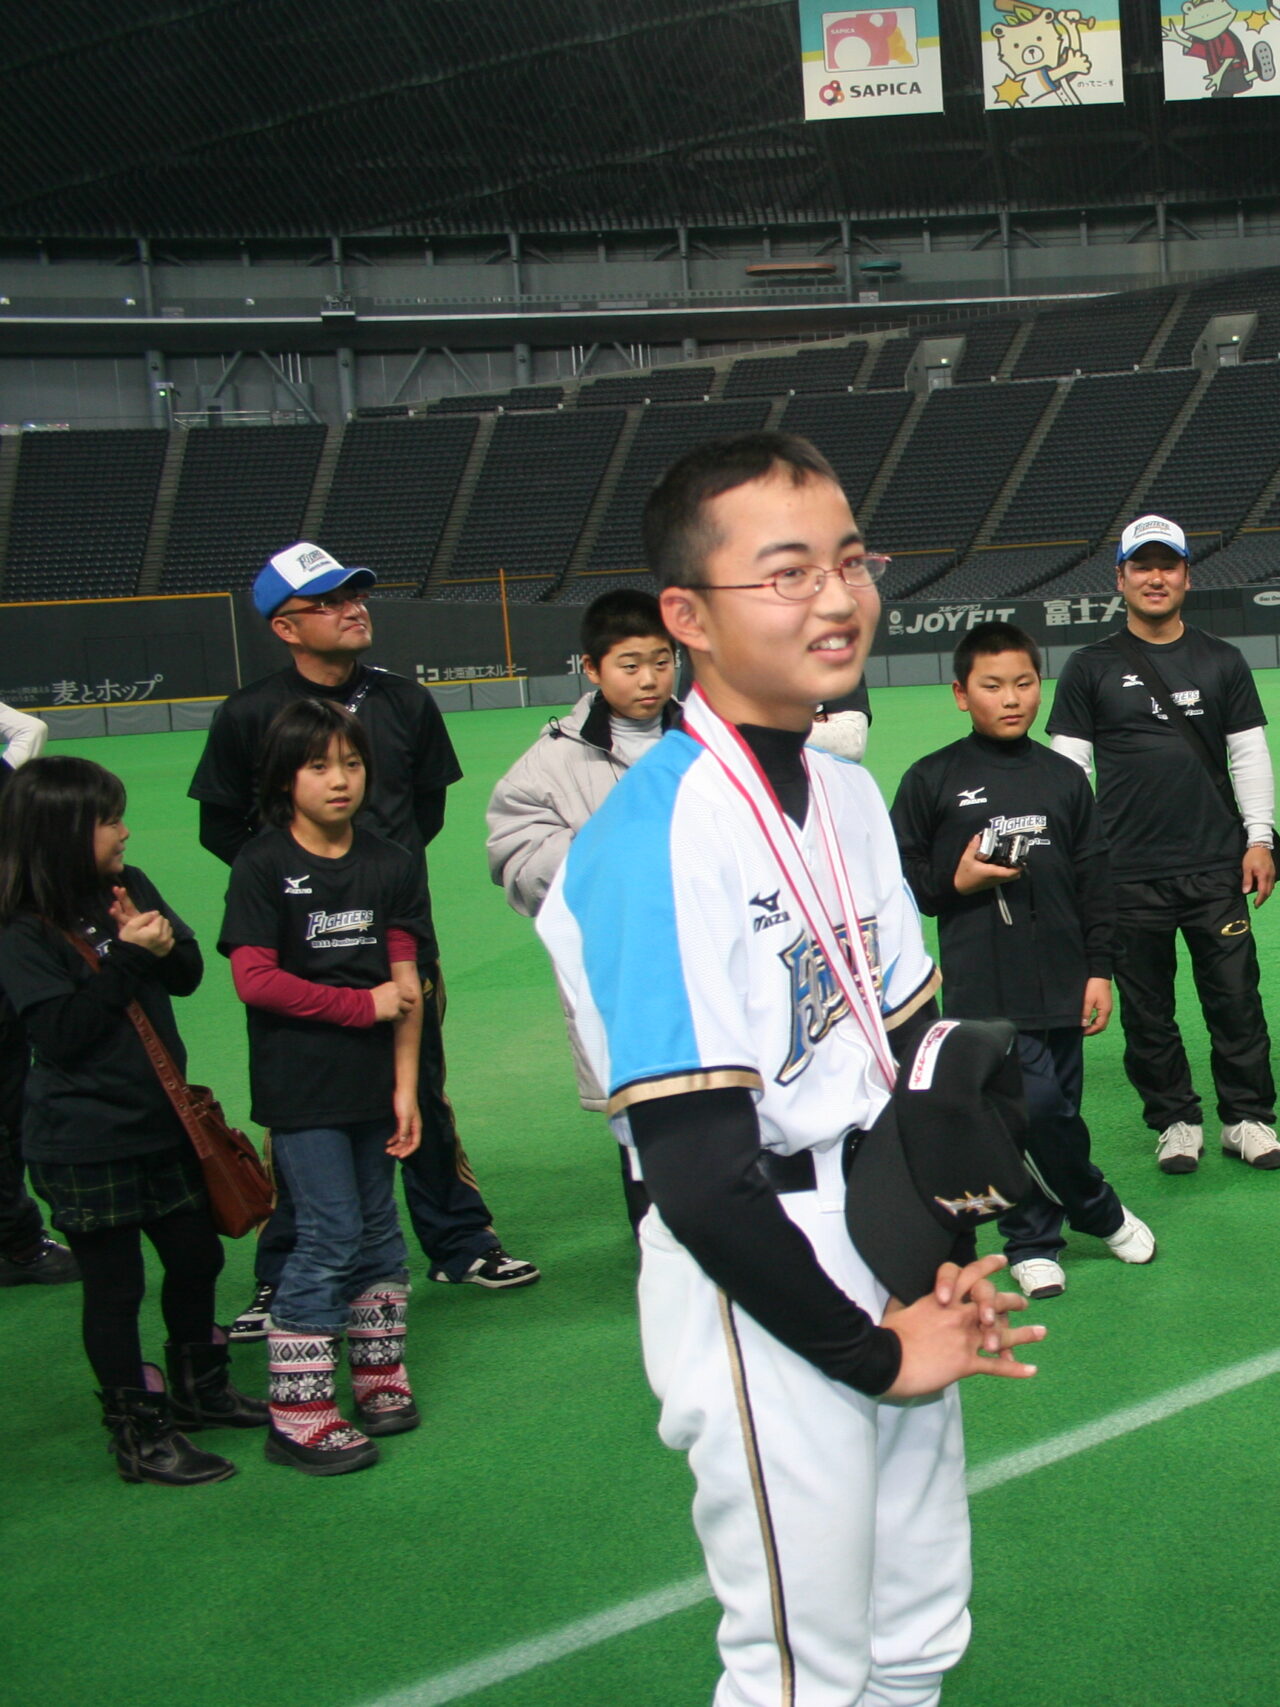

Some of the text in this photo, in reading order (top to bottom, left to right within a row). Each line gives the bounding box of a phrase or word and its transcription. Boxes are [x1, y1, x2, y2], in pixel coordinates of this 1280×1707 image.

[849, 82, 922, 98] SAPICA
[905, 608, 1016, 634] JOYFIT
[51, 673, 164, 706] 麦とホップ
[306, 910, 374, 941] FIGHTERS
